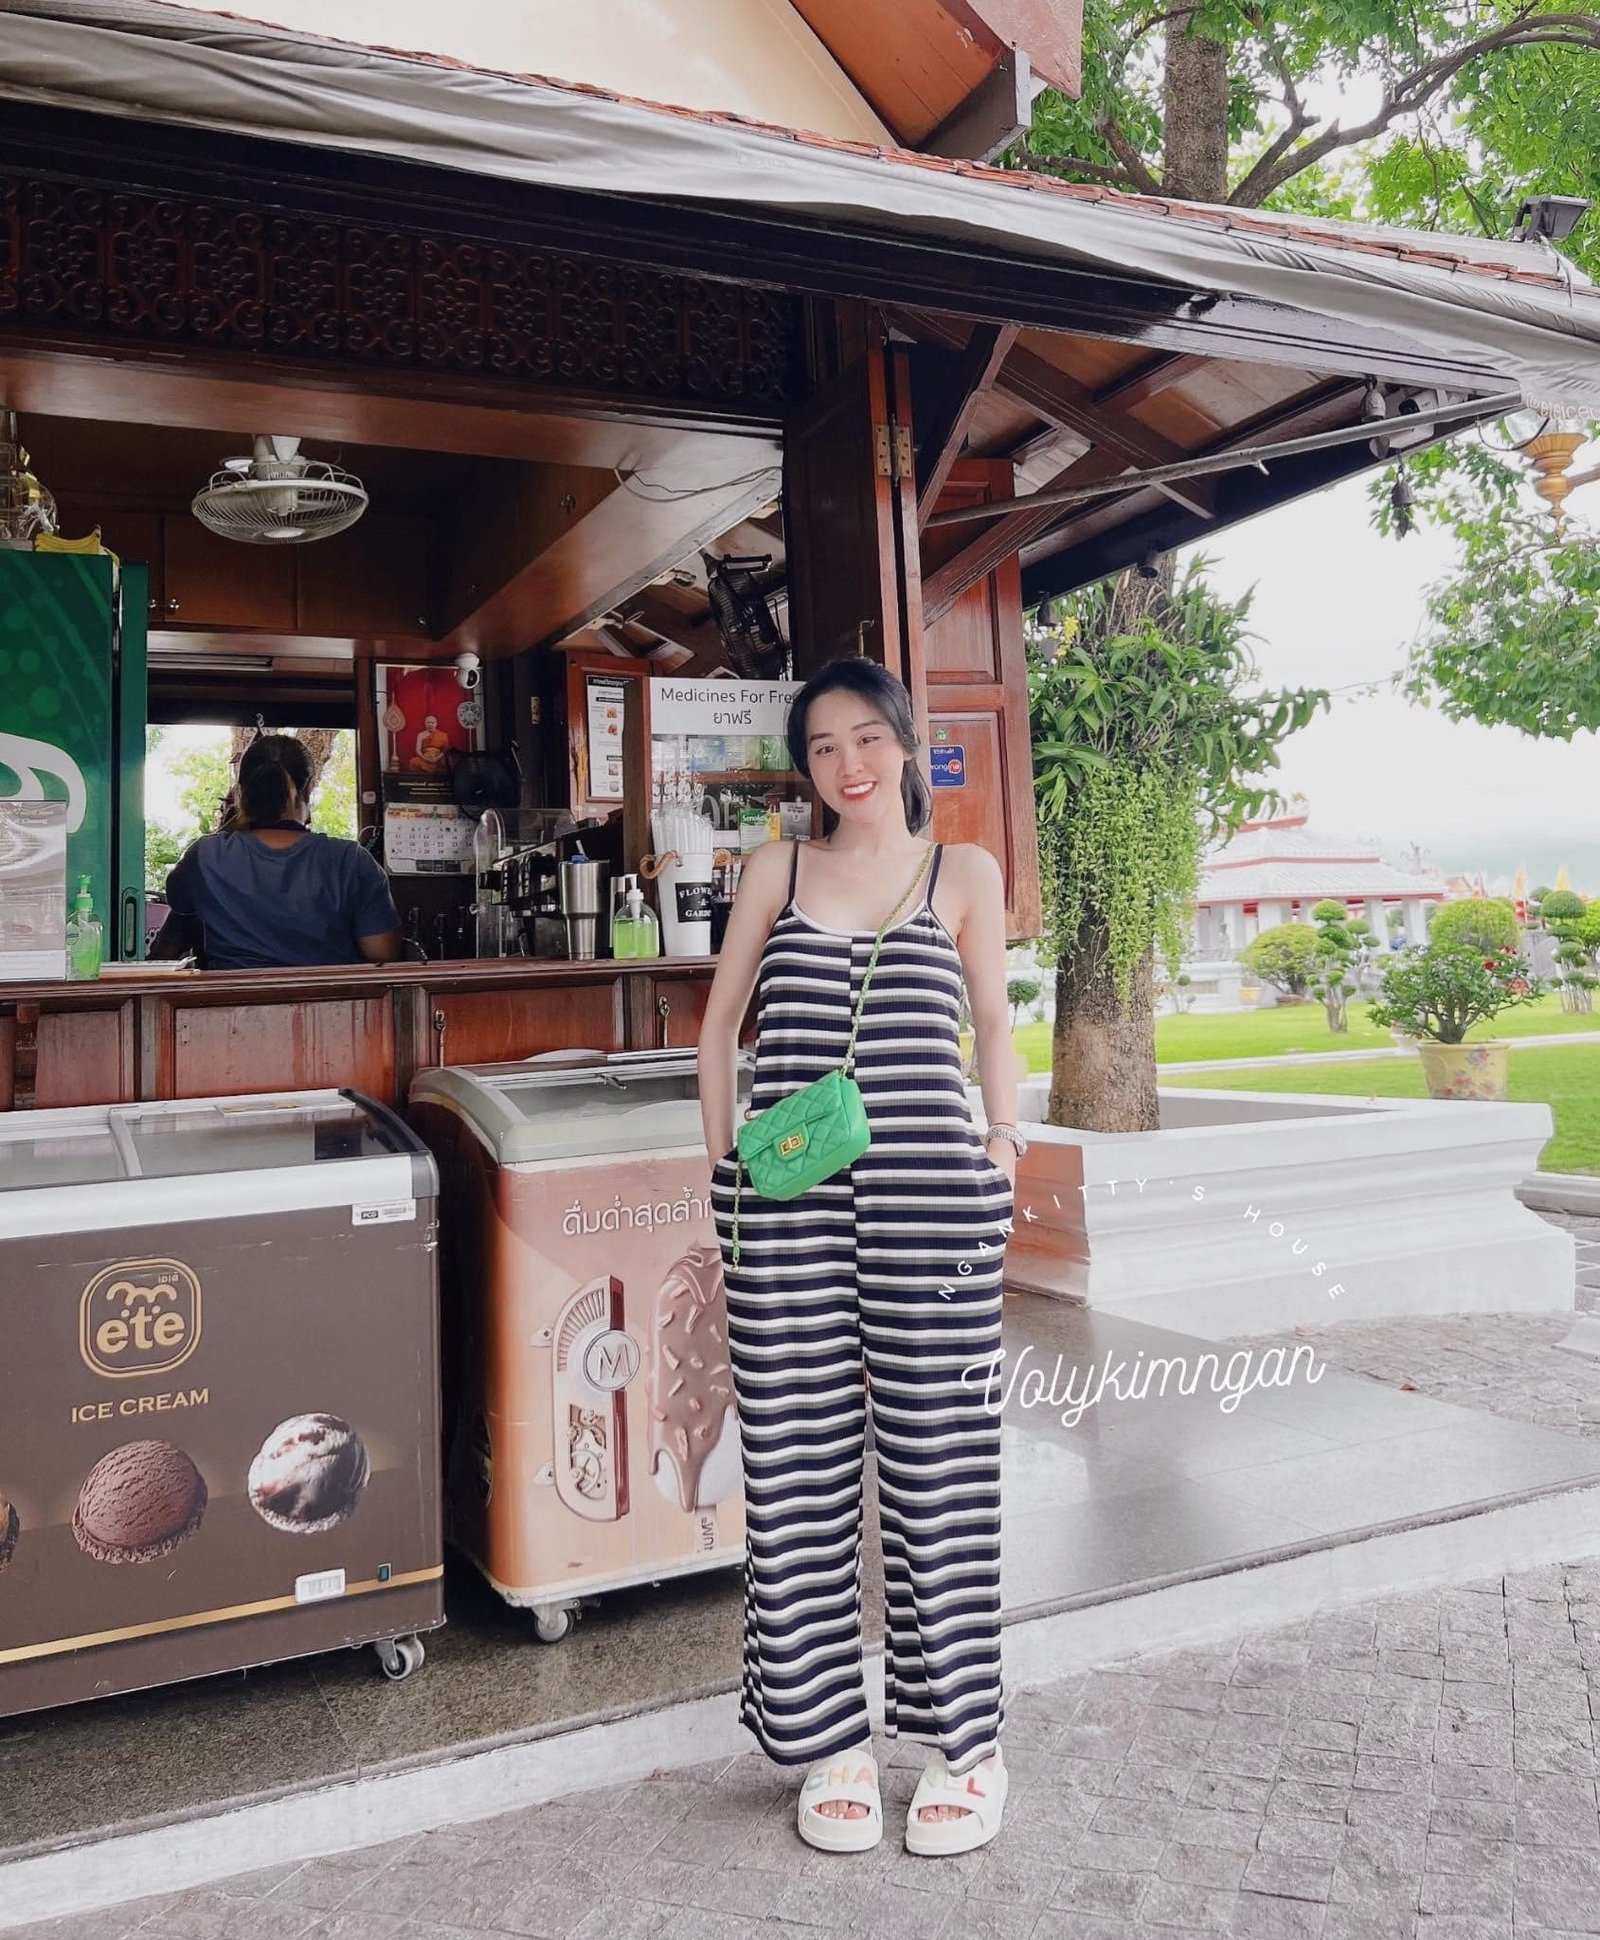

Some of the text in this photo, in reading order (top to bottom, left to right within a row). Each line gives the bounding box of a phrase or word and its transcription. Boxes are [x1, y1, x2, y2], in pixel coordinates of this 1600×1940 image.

[661, 687, 736, 703] Medicines
[741, 689, 765, 704] For
[713, 709, 752, 725] ยาฟรี
[592, 1342, 632, 1381] M
[71, 1387, 209, 1423] ICE CREAM
